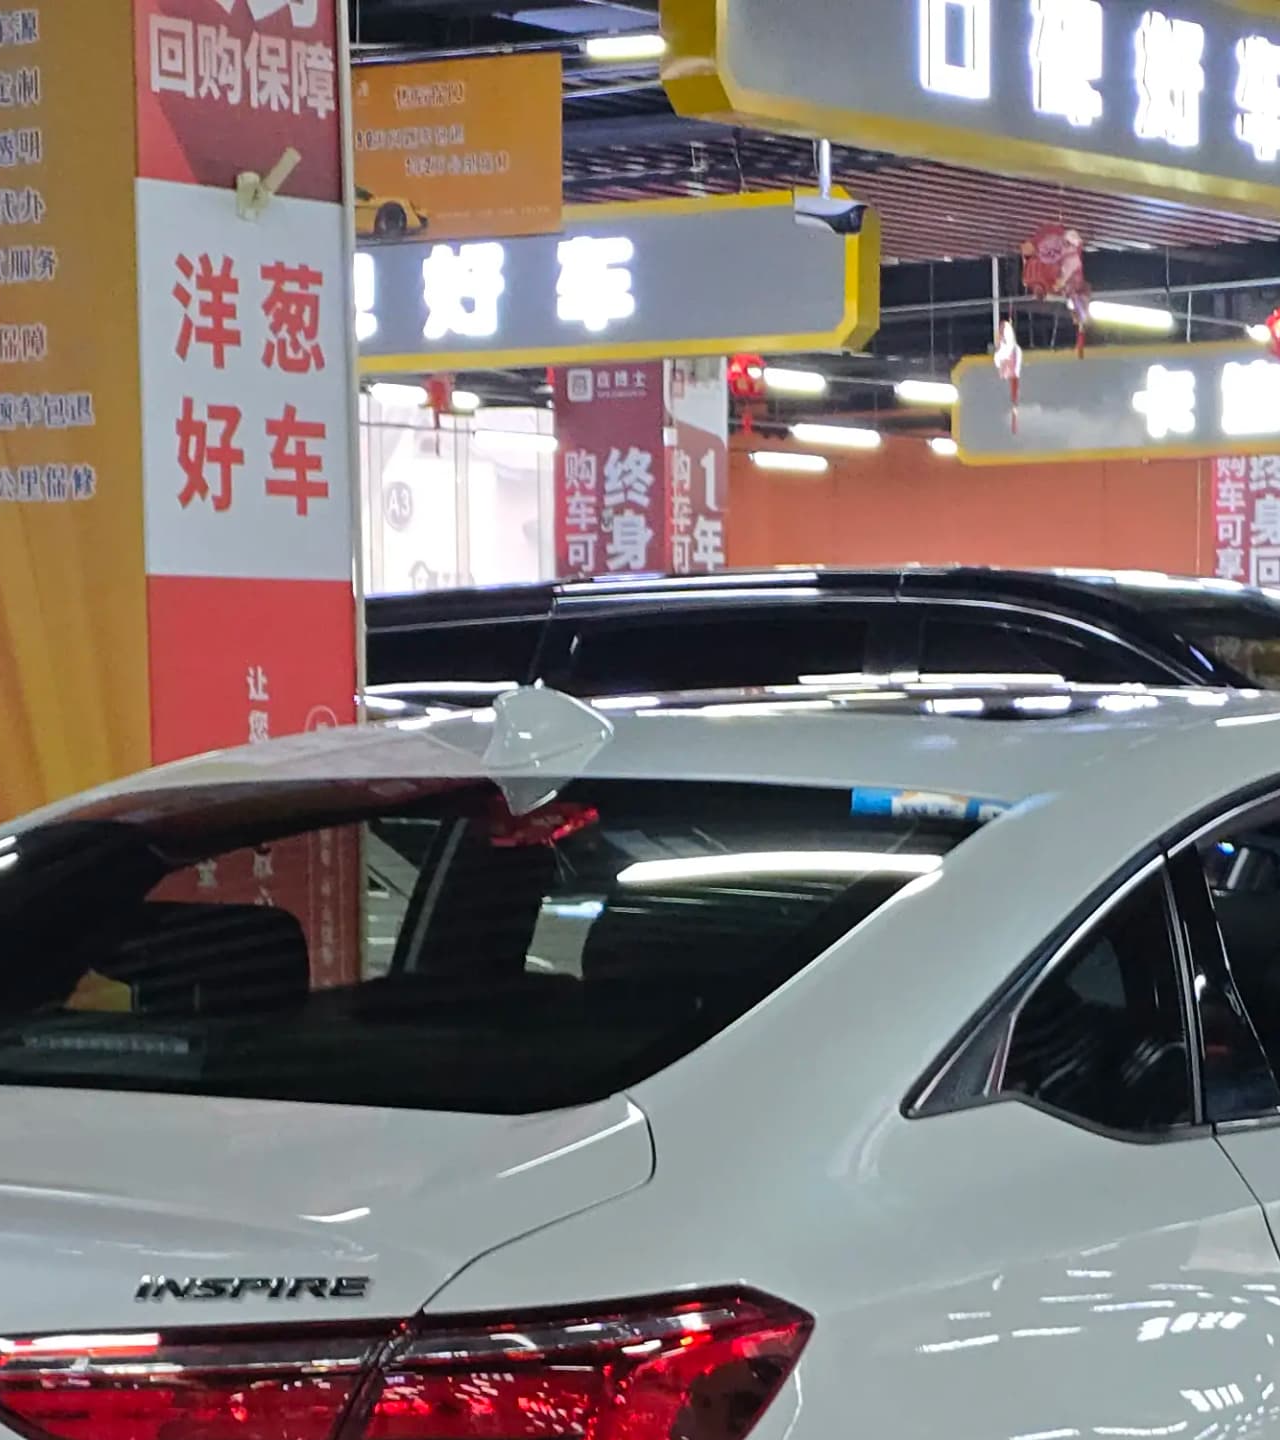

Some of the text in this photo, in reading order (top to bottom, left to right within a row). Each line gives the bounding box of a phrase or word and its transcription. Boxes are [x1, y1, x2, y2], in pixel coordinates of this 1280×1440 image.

[149, 13, 335, 120] 回购保障
[172, 253, 326, 375] 洋葱
[175, 396, 330, 517] 好车
[603, 447, 654, 570] 终身
[134, 1274, 373, 1301] INSPIRE
